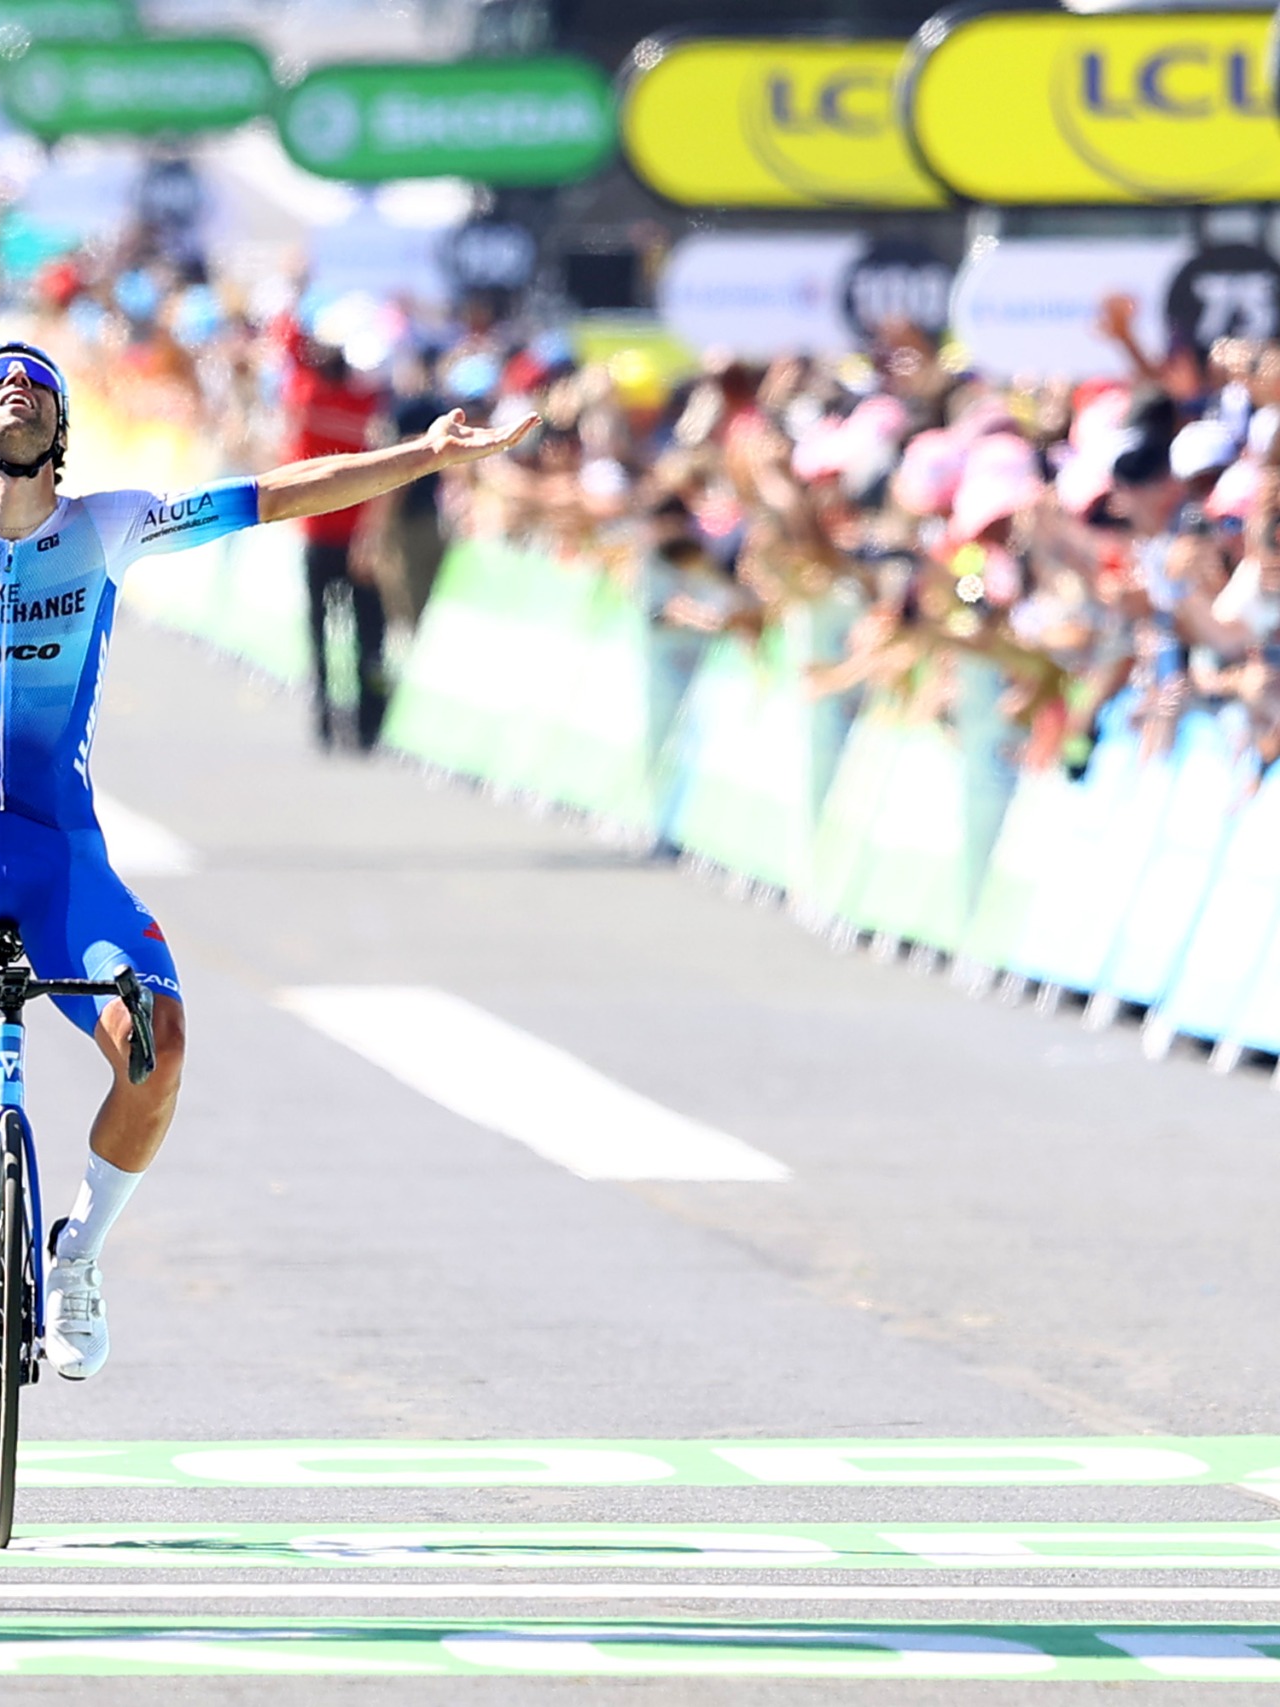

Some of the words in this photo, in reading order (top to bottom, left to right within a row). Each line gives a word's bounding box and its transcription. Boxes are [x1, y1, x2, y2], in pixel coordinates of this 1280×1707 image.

[1081, 45, 1273, 119] LCL
[1191, 270, 1275, 344] 75
[142, 492, 214, 531] ALULA
